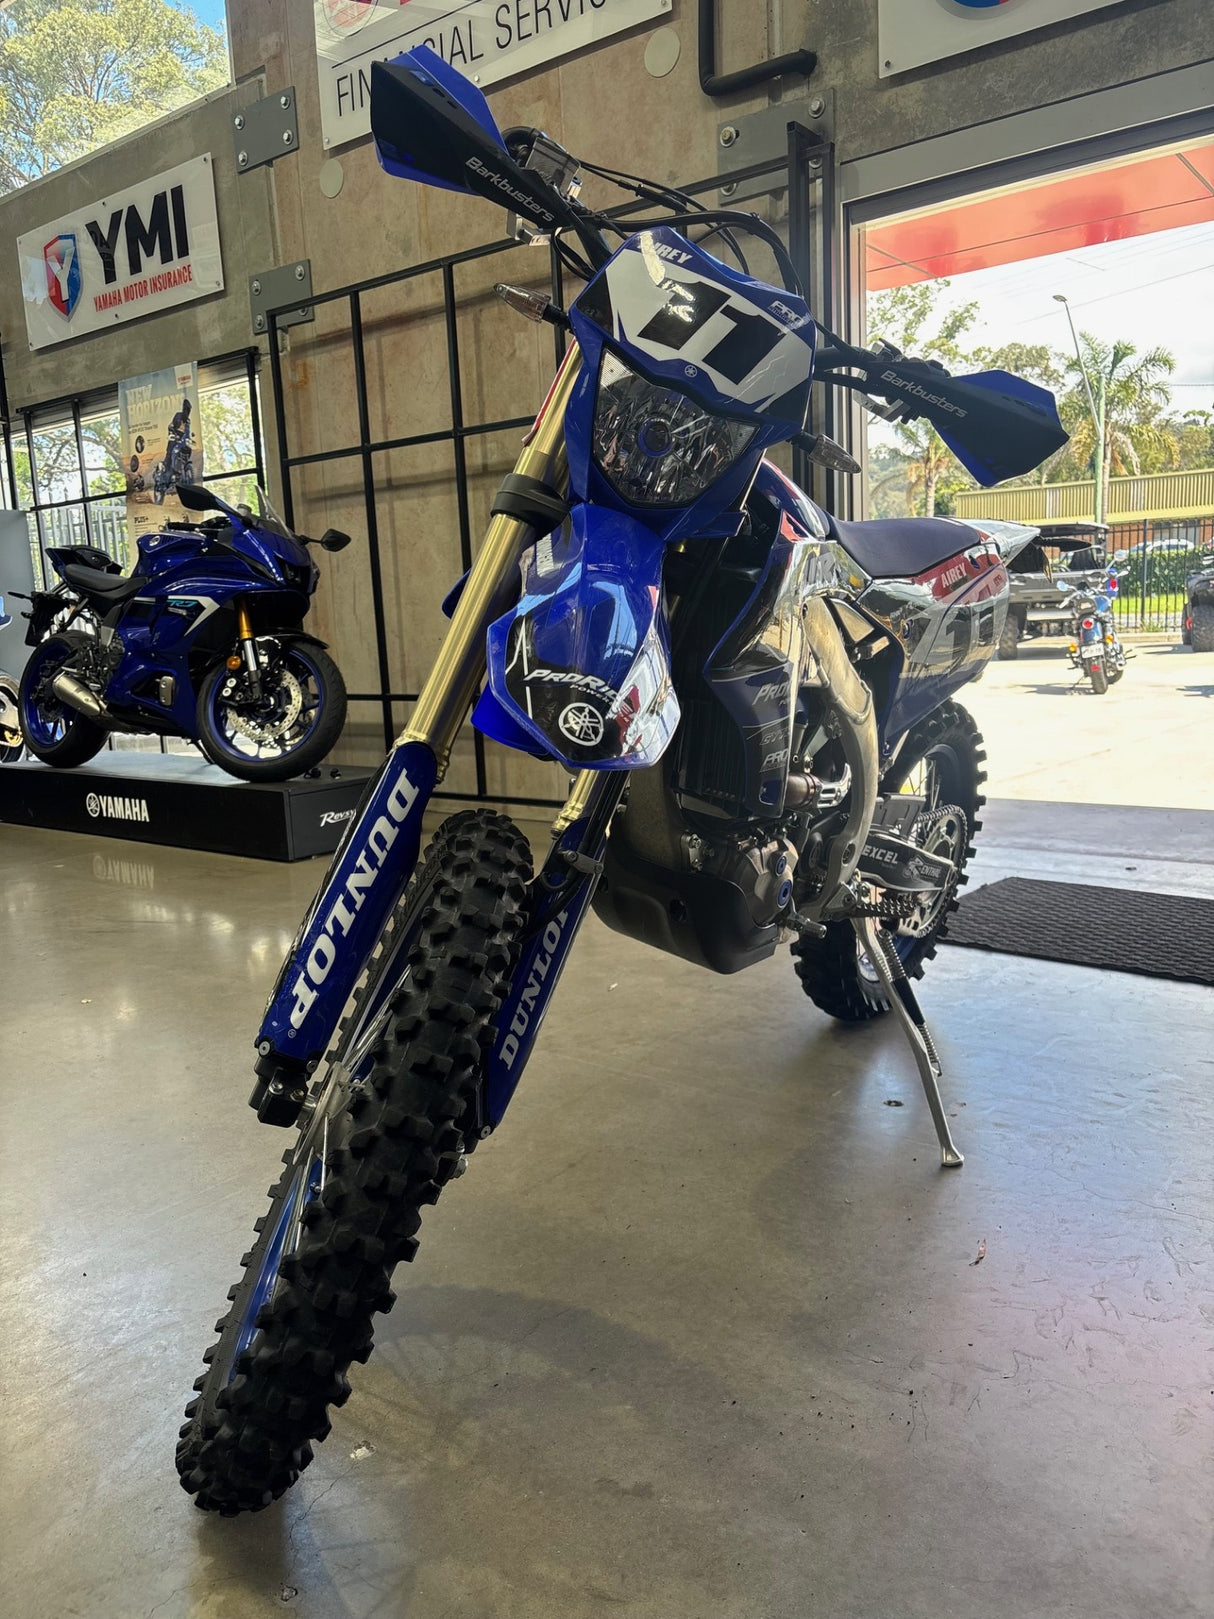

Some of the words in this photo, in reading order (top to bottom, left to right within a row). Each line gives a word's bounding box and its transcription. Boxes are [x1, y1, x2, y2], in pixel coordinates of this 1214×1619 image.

[465, 156, 555, 222] Barkbusters
[85, 184, 189, 285] YMI
[94, 289, 123, 312] YAMAHA
[123, 280, 149, 303] MOTOR
[149, 264, 193, 294] INSURANCE
[126, 384, 152, 404] NEW
[881, 369, 968, 418] Barkbusters
[941, 562, 968, 589] AIREY
[99, 794, 150, 822] YAMAHA
[862, 845, 899, 865] EXCEL
[289, 767, 420, 1030] DUNLOP
